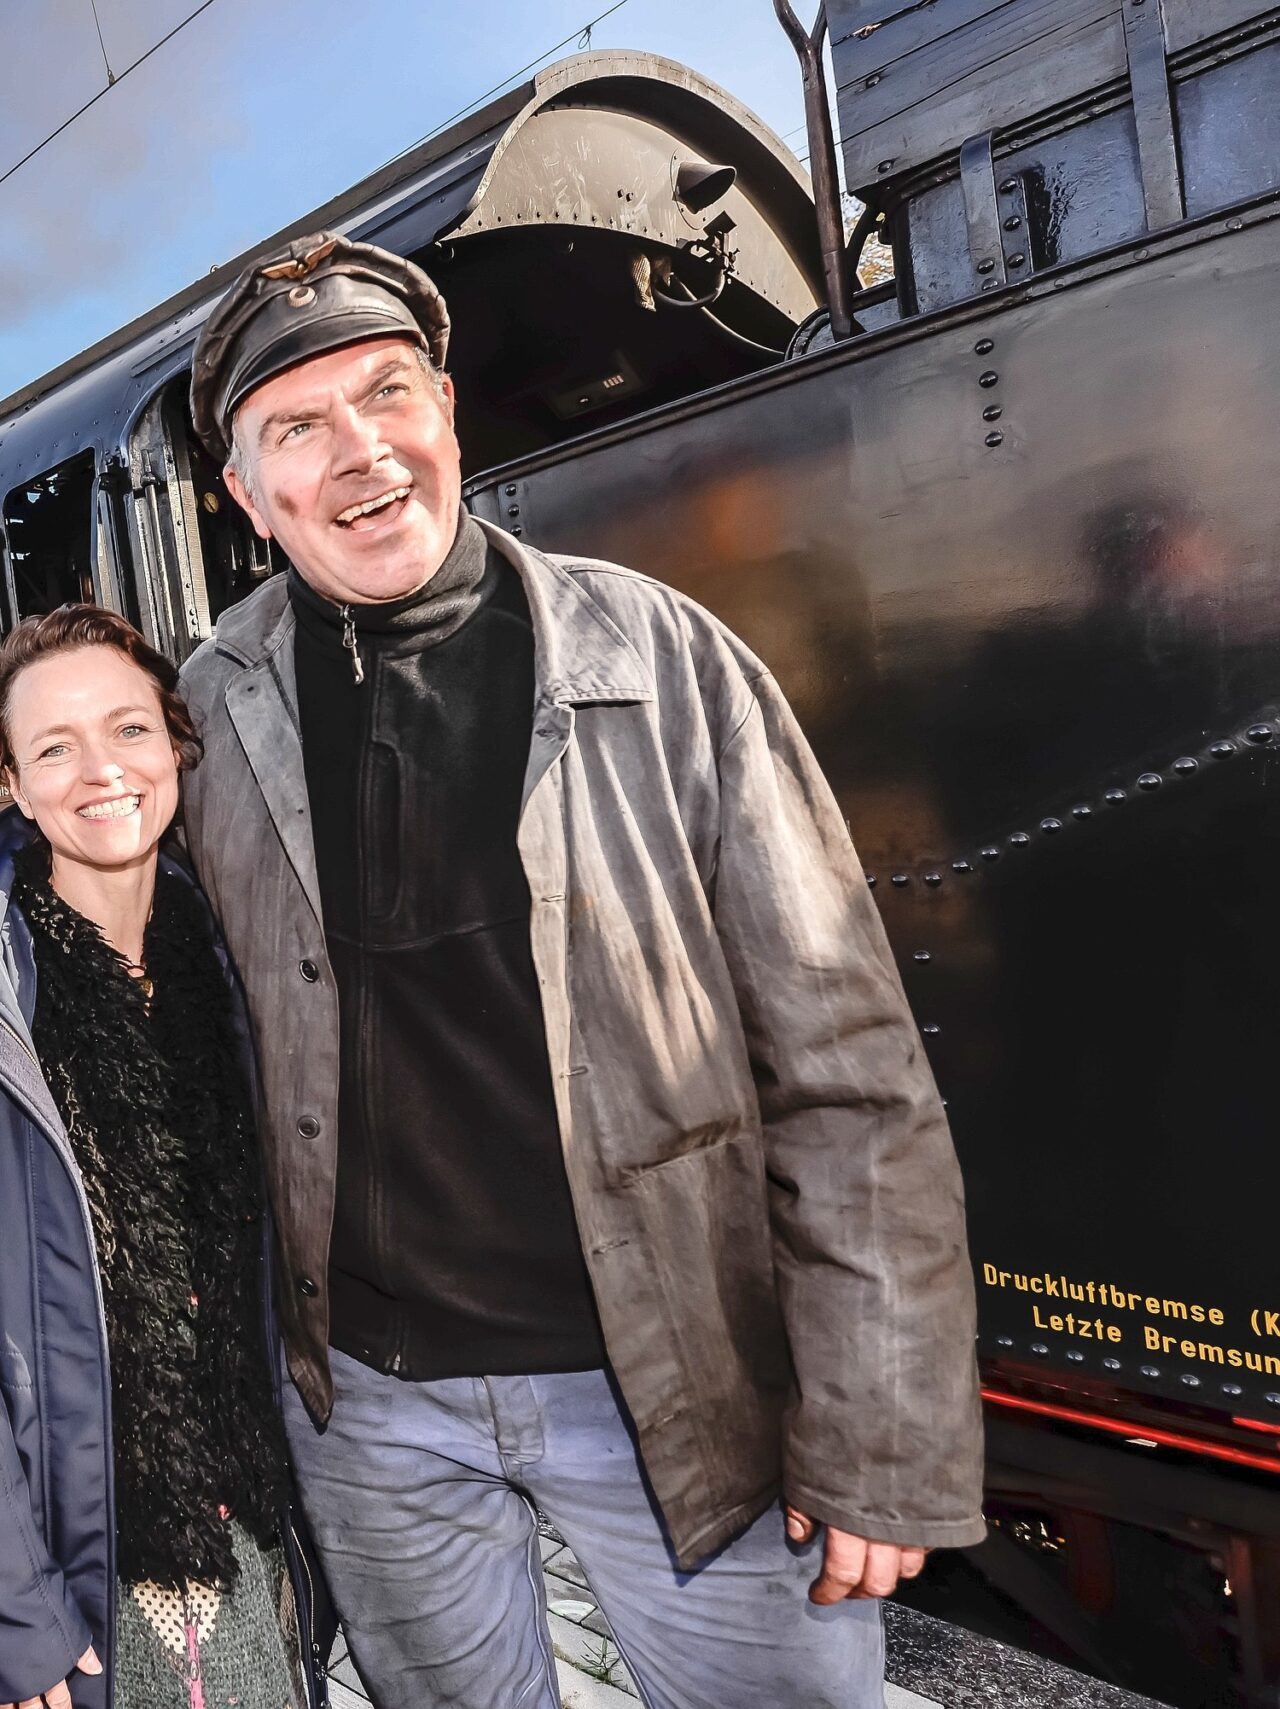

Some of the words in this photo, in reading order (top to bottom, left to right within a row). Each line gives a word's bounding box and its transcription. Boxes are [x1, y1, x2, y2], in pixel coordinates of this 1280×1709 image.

[983, 1263, 1224, 1326] Druckluftbremse
[1032, 1305, 1122, 1343] Letzte
[1144, 1326, 1280, 1376] Bremsun
